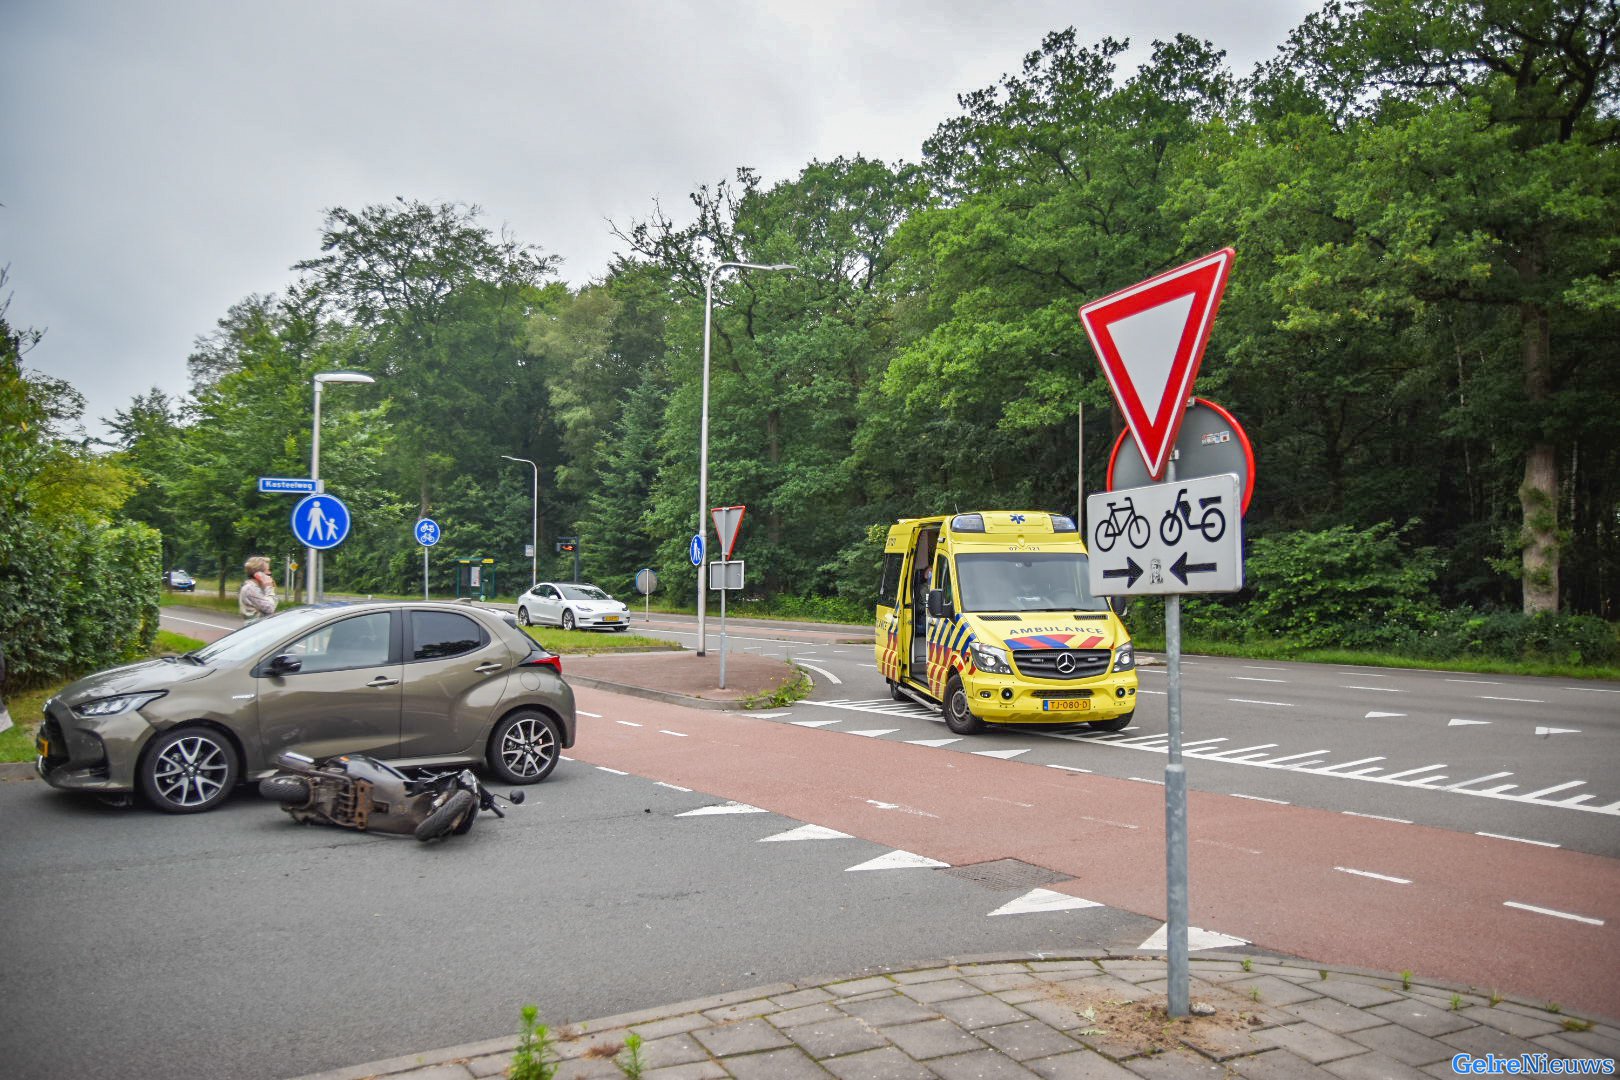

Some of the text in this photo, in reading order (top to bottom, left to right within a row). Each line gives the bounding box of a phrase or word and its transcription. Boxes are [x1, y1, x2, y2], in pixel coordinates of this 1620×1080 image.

[265, 480, 313, 491] Kasteelweg
[1009, 626, 1104, 635] AMBULANCE
[1050, 701, 1088, 709] TJ-080-D
